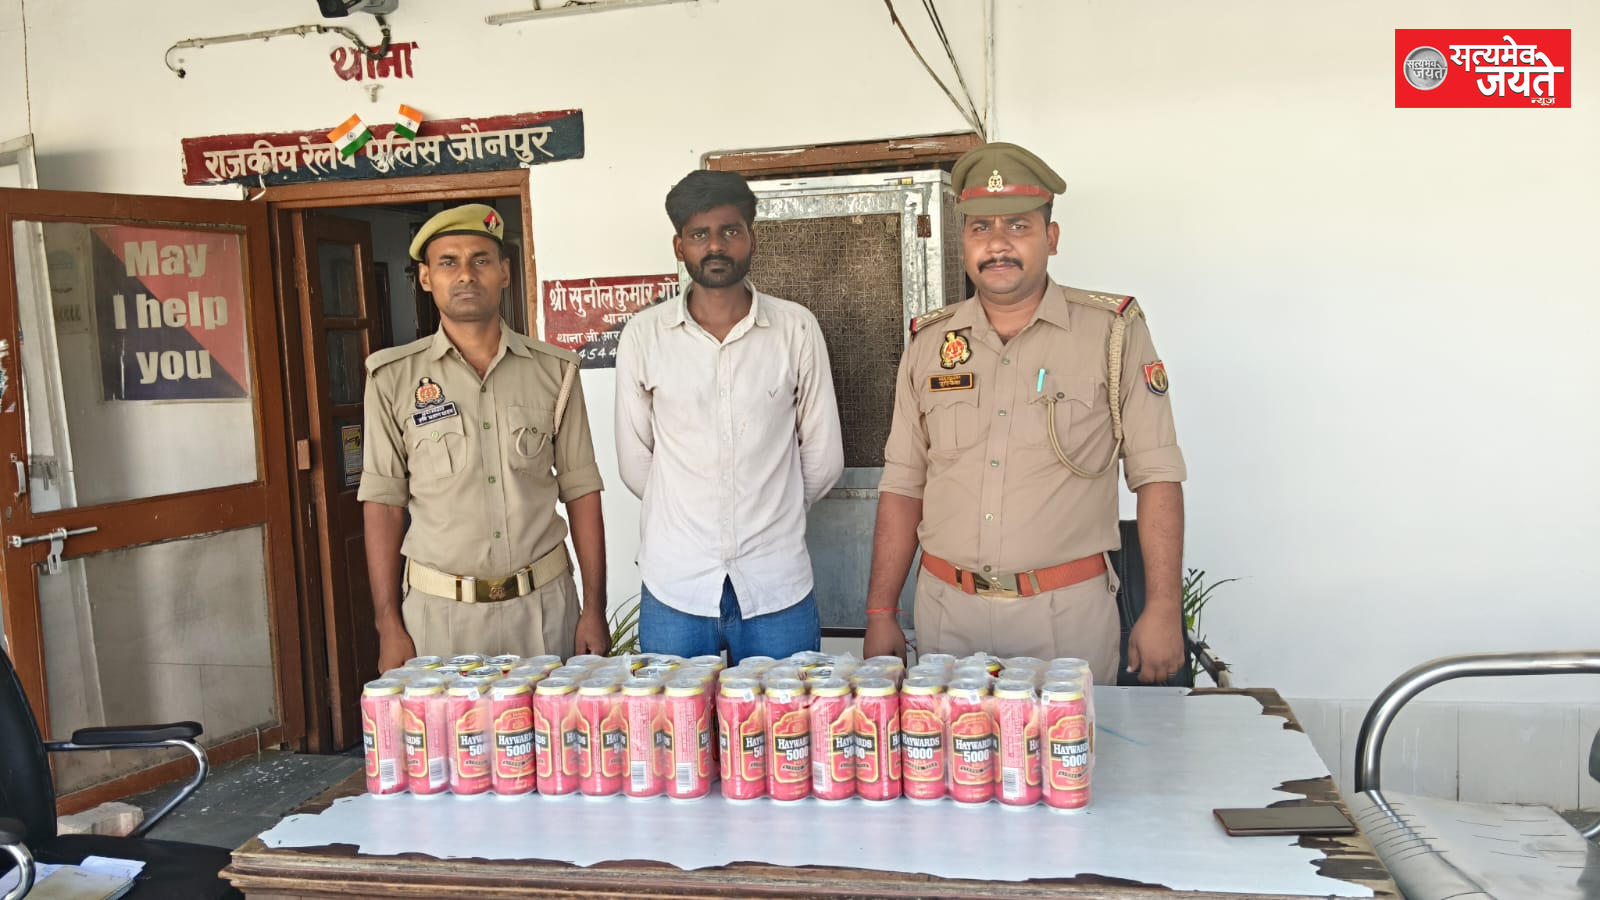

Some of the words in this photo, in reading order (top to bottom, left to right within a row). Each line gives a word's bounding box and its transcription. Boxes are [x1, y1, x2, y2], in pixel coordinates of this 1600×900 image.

[330, 41, 418, 81] थाना
[203, 139, 299, 179] राजकीय
[366, 131, 446, 173] पुलिस
[448, 123, 554, 164] जौनपुर
[124, 240, 208, 278] May
[113, 294, 127, 329] I
[136, 291, 228, 330] help
[549, 281, 567, 311] श्री
[568, 279, 614, 318] सुनील
[614, 280, 655, 312] कुमार
[557, 333, 584, 344] थाना
[136, 350, 212, 384] you
[505, 743, 532, 757] 5000
[903, 733, 939, 747] HAYWARDS
[907, 747, 933, 760] 5000
[963, 749, 989, 762] 5000
[1062, 753, 1087, 768] 5000
